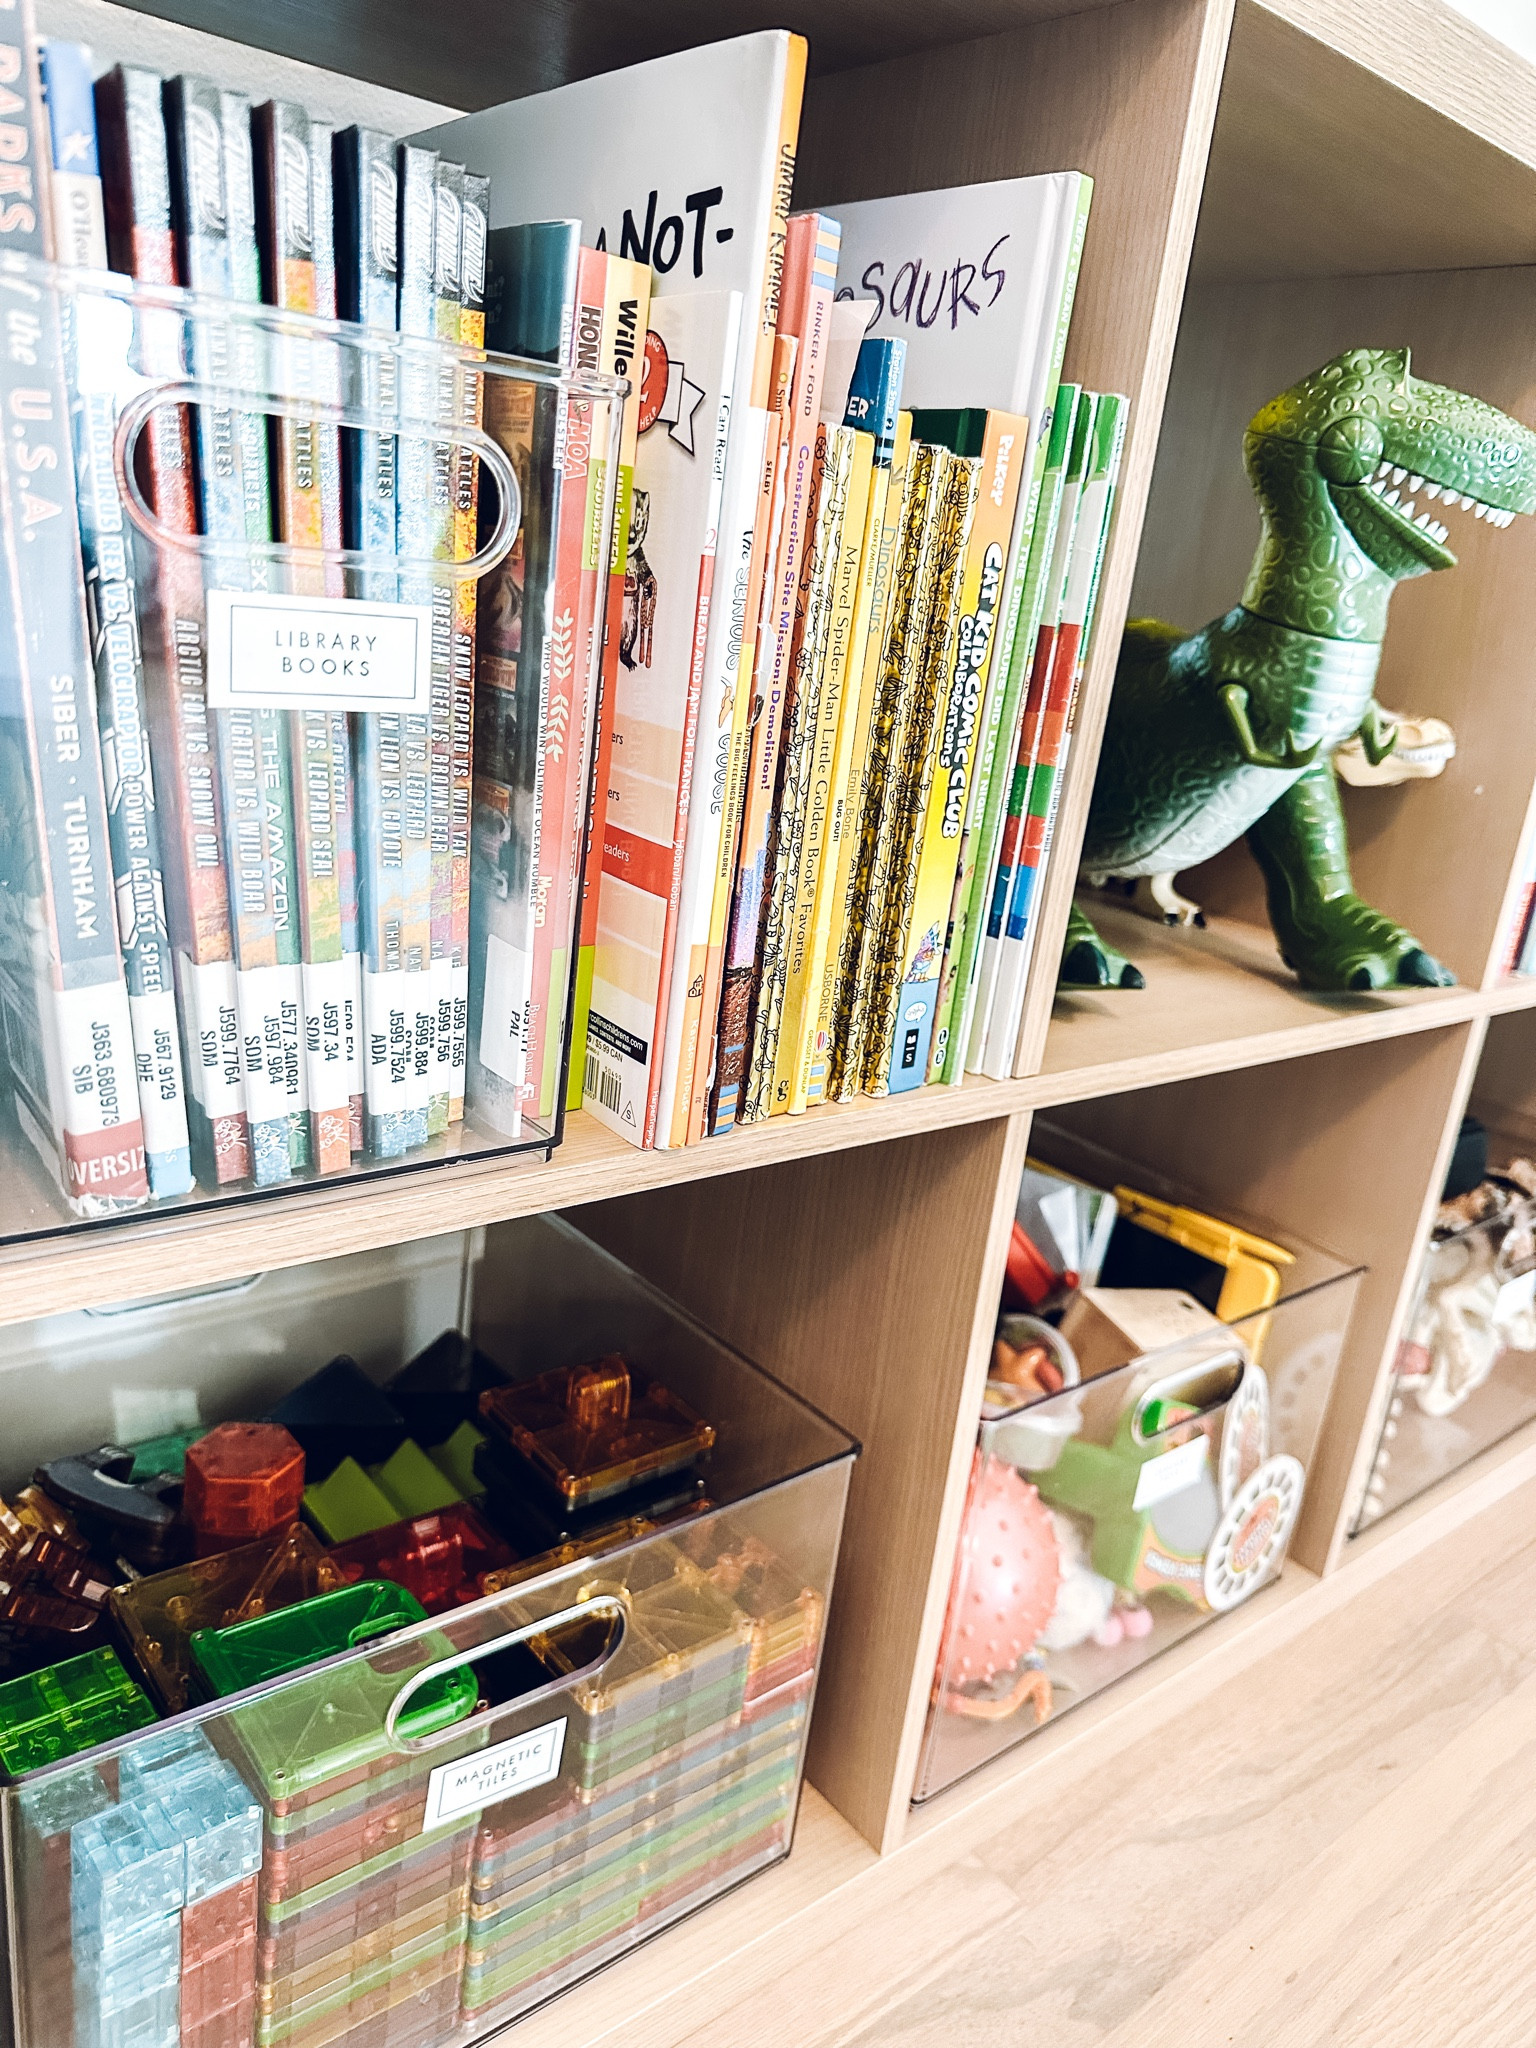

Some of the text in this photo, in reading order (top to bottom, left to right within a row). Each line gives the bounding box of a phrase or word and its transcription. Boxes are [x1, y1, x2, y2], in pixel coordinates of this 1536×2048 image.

[763, 143, 797, 337] JIMMY KIMMEL
[1060, 271, 1078, 323] SUSAN
[8, 309, 42, 367] the
[804, 301, 824, 417] RINKER FORD
[1053, 326, 1068, 370] TUMA
[889, 349, 903, 389] Station
[639, 406, 657, 429] HELP
[717, 404, 730, 433] Can
[887, 390, 898, 415] Stop
[10, 387, 63, 543] U.S.A.
[564, 418, 592, 480] MOA
[711, 439, 727, 482] Read!
[763, 460, 773, 496] SELBY
[101, 537, 122, 581] REX
[704, 528, 717, 550] 2
[980, 541, 1004, 606] CAT
[275, 629, 377, 652] LIBRARY
[760, 445, 810, 790] Construction Site Mission: Demolition!
[282, 656, 370, 677] BOOKS
[842, 526, 896, 839] Dinosaurs Emily Bone
[973, 479, 1041, 830] WHAT THE DINOSAURS DID LAST NIGHT
[431, 586, 452, 853] SIBERIAN TIGER VS. BROWN BEAR
[677, 595, 710, 817] BREAD AND JAM FOR FRANCES
[175, 618, 220, 868] ARCTIC FOX VS. SNOWY OWL
[261, 730, 281, 790] THE
[306, 730, 327, 755] VS.
[380, 736, 400, 774] LION
[406, 742, 426, 765] VS.
[452, 633, 472, 858] SNOW LEOPARD VS. WILD YAK
[792, 545, 859, 975] Marvel Spider-Man Little Golden Favorites
[307, 762, 332, 833] LEOPARD
[381, 780, 401, 804] VS.
[530, 641, 552, 907] WHO WOULD WIN? ULTIMATE OCEAN RUMBLE
[729, 765, 738, 802] FEELINGS
[52, 674, 100, 941] SIBER TURNHAM
[124, 780, 149, 850] POWER
[406, 771, 426, 840] LEOPARD
[724, 824, 732, 839] FOR
[726, 803, 735, 823] BOOK
[835, 799, 844, 821] BUG
[941, 767, 967, 839] CLUB
[235, 788, 266, 914] VS. WILD BOAR
[266, 800, 289, 932] AMAZON
[311, 840, 334, 878] SEAL
[381, 811, 402, 868] COYOTE
[720, 840, 731, 878] CHILDREN
[131, 856, 158, 935] AGAINST
[534, 875, 553, 928] Moran
[139, 941, 163, 995] SPEED
[818, 963, 835, 1023] USBORNE
[200, 1031, 219, 1067] SOM
[219, 1005, 241, 1085] J599.7764
[264, 1015, 284, 1085] J597.984
[306, 1016, 320, 1052] SOM
[323, 1002, 340, 1062] J597.34
[371, 1034, 387, 1066] ADA
[390, 1009, 406, 1084] J599.7524
[415, 1011, 430, 1077] J599.884
[437, 998, 451, 1063] J599.756
[451, 997, 467, 1068] J599.7555
[509, 1010, 521, 1038] PAL
[806, 1029, 814, 1060] GROSSET
[72, 1065, 94, 1095] SIB
[91, 1021, 120, 1127] J363.680973
[153, 1029, 176, 1101] J567.9129
[244, 1035, 263, 1073] SOM
[610, 1049, 623, 1064] CAN
[455, 1744, 543, 1787] MAGNETIC
[478, 1767, 518, 1791] TILES
